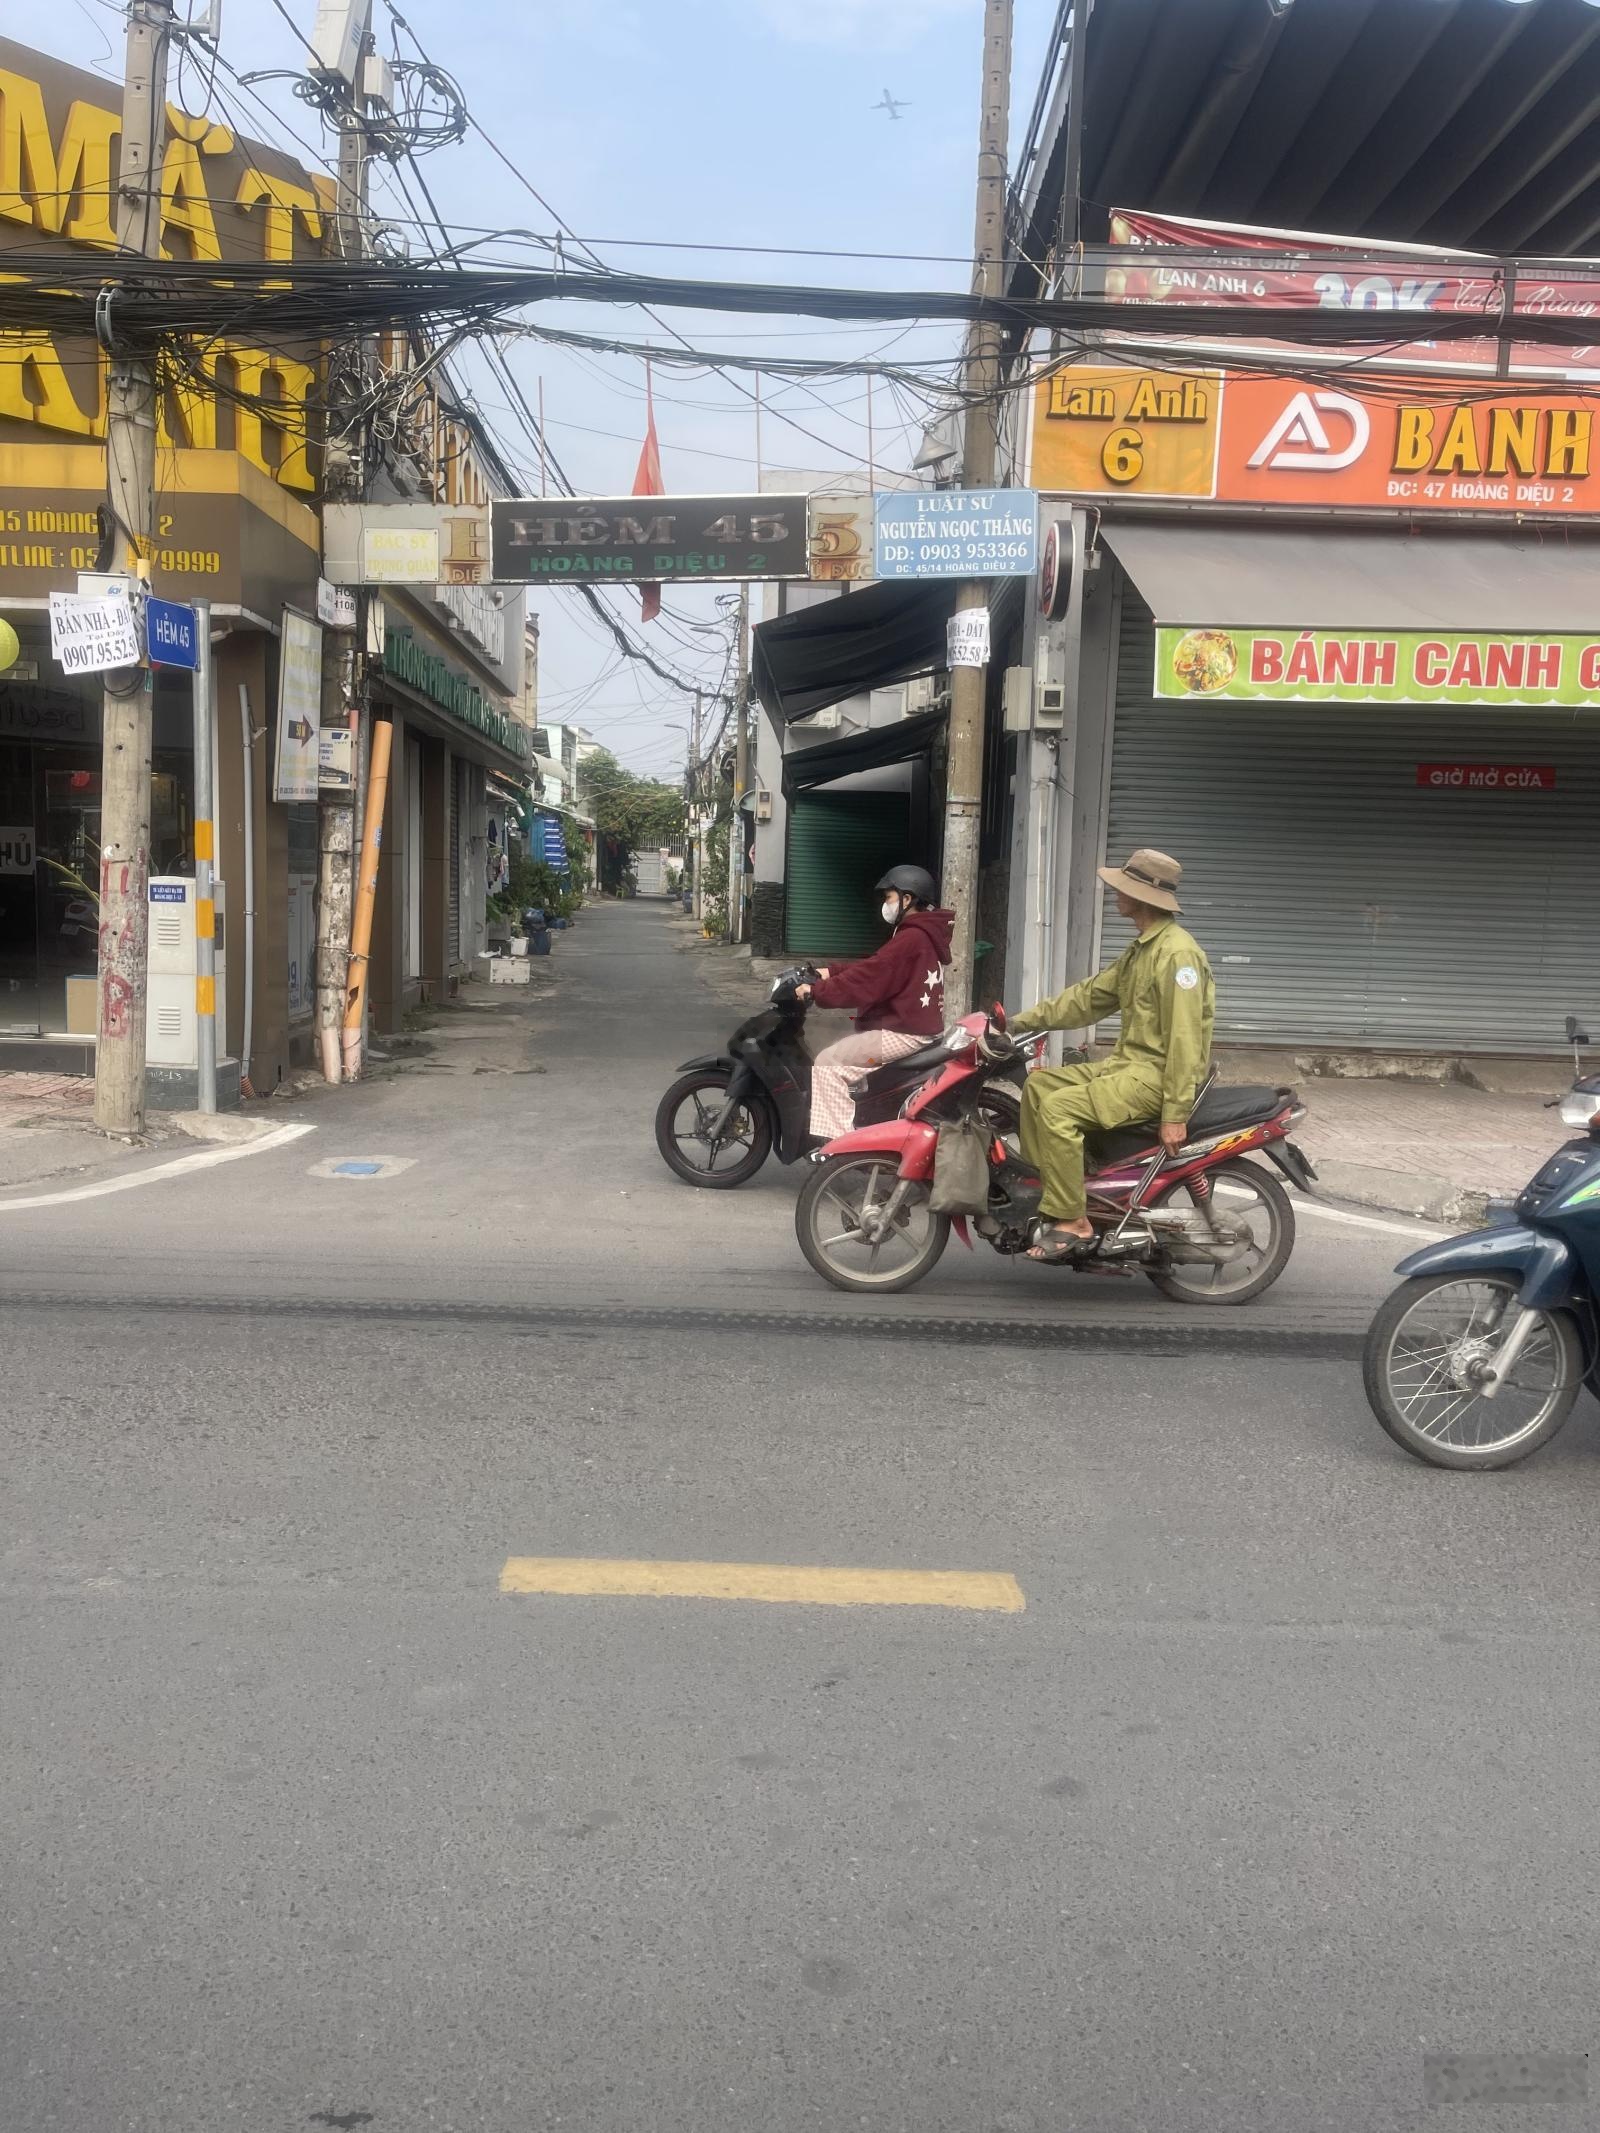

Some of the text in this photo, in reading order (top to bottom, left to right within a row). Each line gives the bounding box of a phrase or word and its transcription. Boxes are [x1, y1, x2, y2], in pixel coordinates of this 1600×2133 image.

[1157, 267, 1266, 297] LAN ANH 6
[1047, 376, 1208, 423] Lan Anh
[1101, 427, 1144, 486] 6
[917, 495, 995, 513] LUẬT SƯ
[1387, 480, 1574, 506] ĐC: 47 HOÀNG DIỆU 2
[159, 514, 174, 537] 2
[508, 506, 789, 546] HẺM 45
[880, 510, 1032, 541] NGUYỄN NGỌC THẮNG
[530, 552, 767, 573] HOÀNG DIỆU 2
[885, 542, 1028, 561] DĐ: 0903 953366
[896, 564, 912, 573] ĐC:
[916, 563, 941, 573] 45/14
[1010, 562, 1016, 570] 2
[83, 605, 111, 632] NHÀ
[156, 612, 190, 648] HẺM 45
[1250, 631, 1398, 687] BÁNH
[1414, 641, 1563, 690] CANH
[1430, 767, 1543, 787] GIỜ MỞ CỬA
